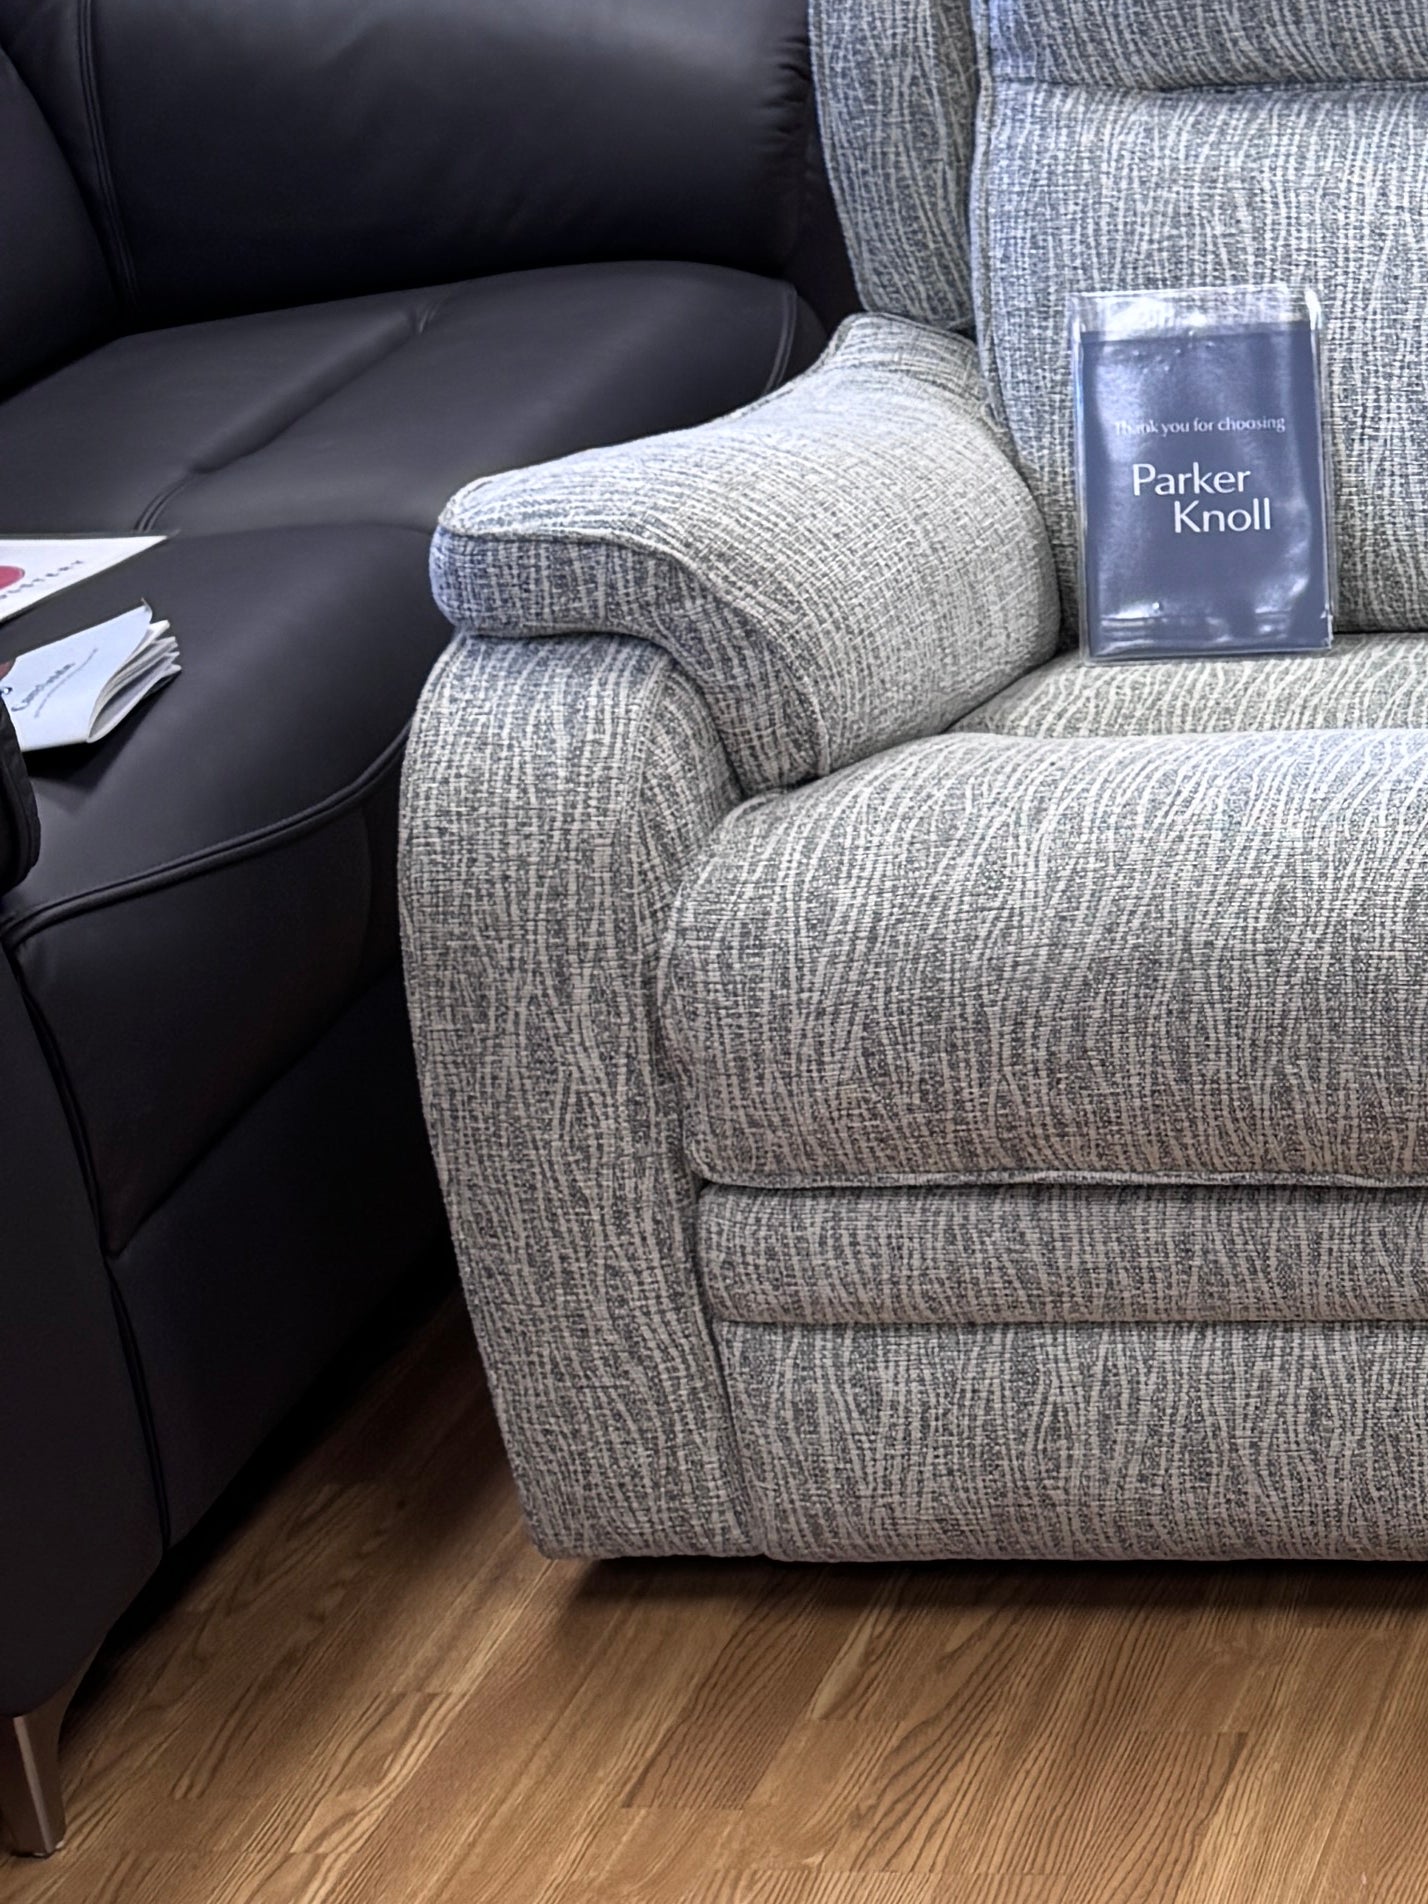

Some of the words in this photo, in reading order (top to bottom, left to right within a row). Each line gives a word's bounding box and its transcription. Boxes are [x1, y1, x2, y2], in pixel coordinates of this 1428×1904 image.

[1161, 421, 1190, 437] you
[1193, 417, 1214, 432] for
[1218, 416, 1286, 433] choosing
[1132, 461, 1252, 496] Parker
[1174, 497, 1271, 533] Knoll
